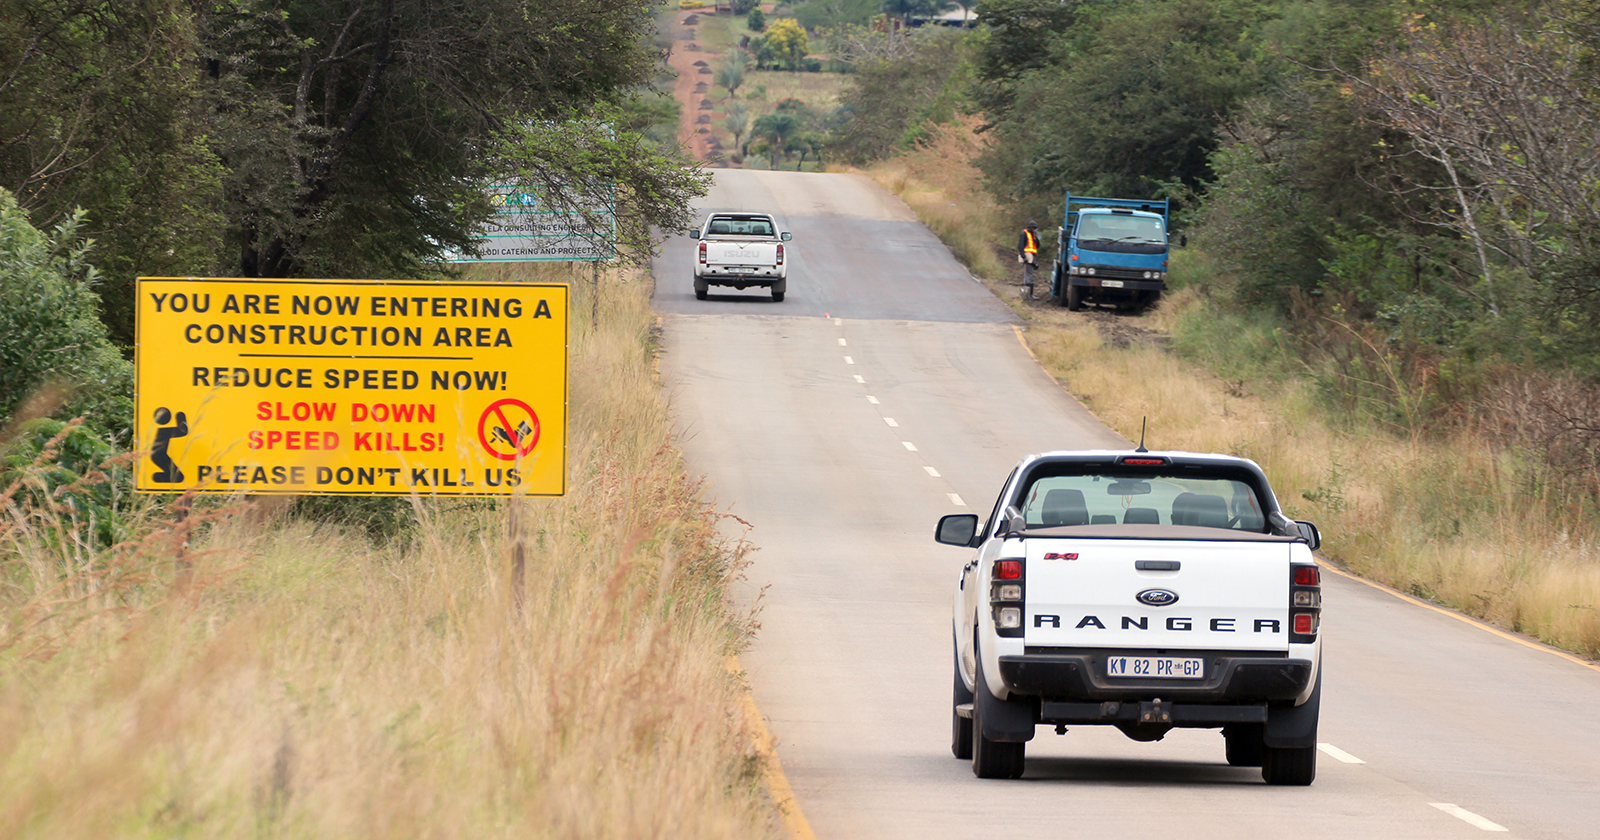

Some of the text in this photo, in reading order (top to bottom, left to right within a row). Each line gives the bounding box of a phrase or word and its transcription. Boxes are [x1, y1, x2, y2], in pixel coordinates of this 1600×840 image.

[501, 248, 539, 256] CATERING
[540, 247, 557, 255] AND
[724, 250, 760, 258] ISUZU
[150, 293, 552, 319] YOU ARE NOW ENTERING A
[185, 324, 513, 348] CONSTRUCTION AREA
[192, 367, 508, 391] REDUCE SPEED NOW!
[256, 401, 436, 423] SLOW DOWN
[248, 430, 445, 452] SPEED KILLS!
[198, 465, 522, 487] PLEASE DON'T KILL US
[1033, 614, 1281, 633] RANGER
[1133, 659, 1150, 674] 82
[1157, 660, 1173, 675] PR
[1183, 660, 1200, 675] GP
